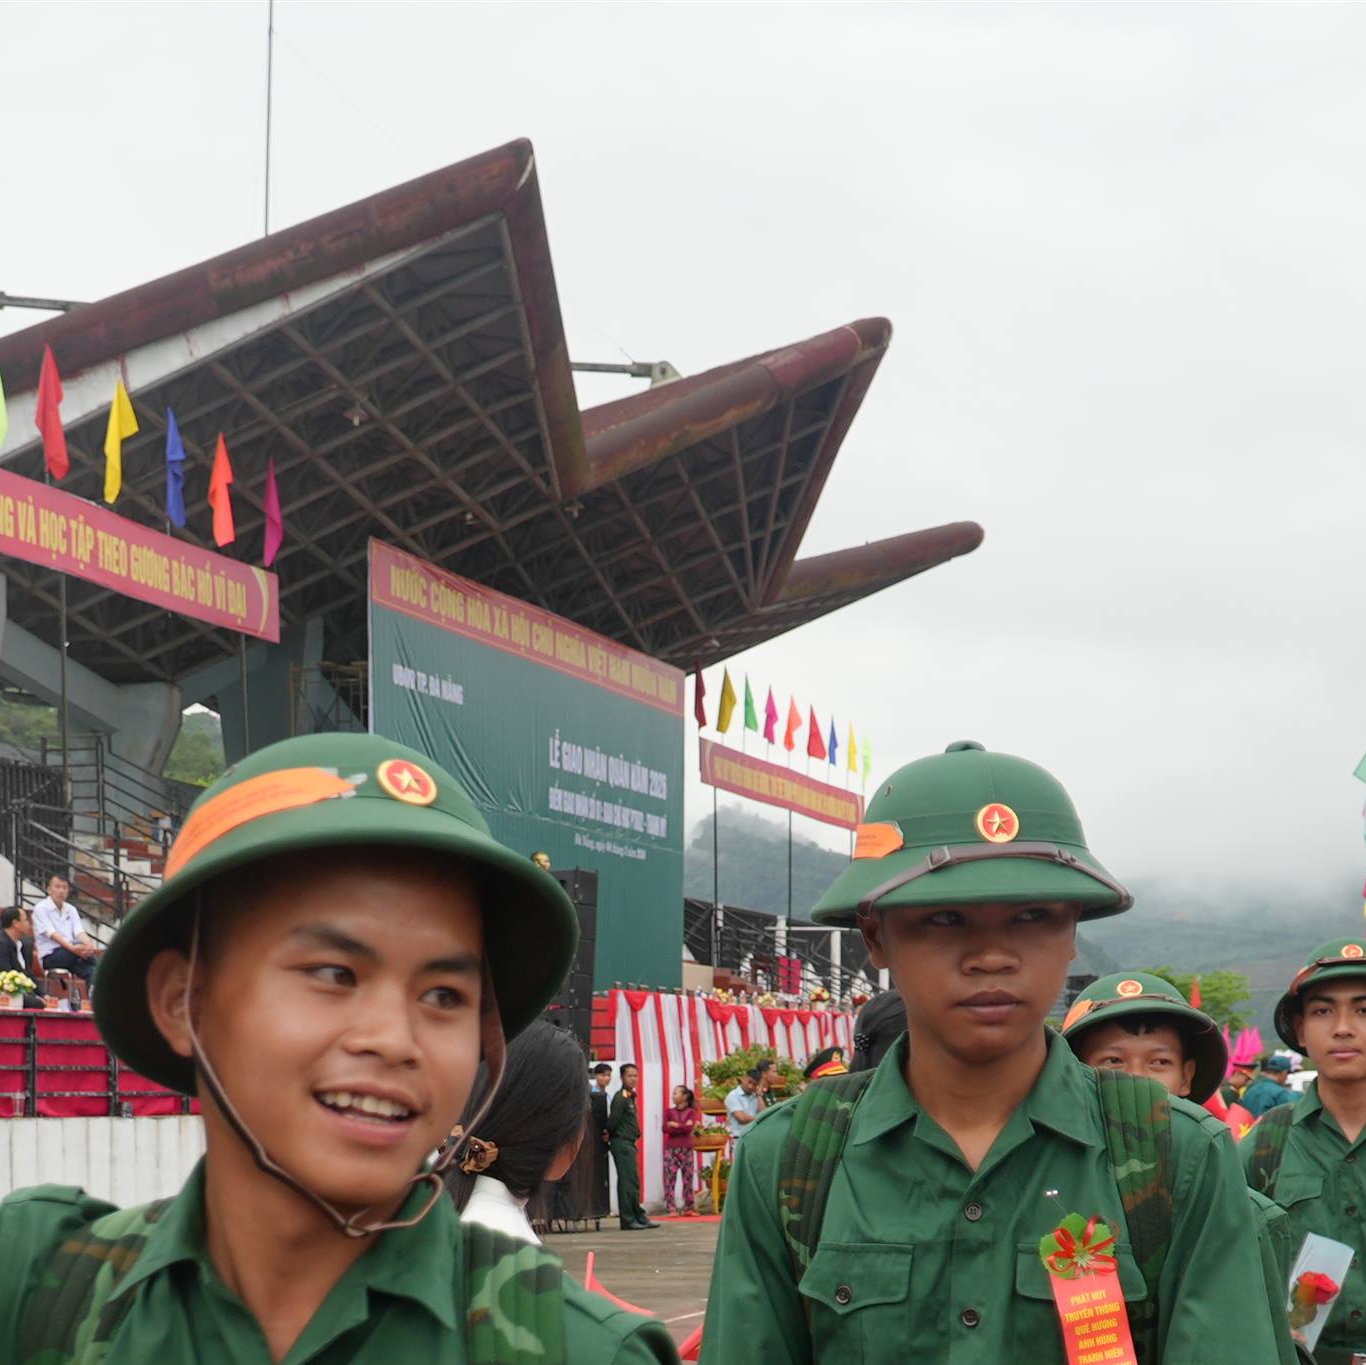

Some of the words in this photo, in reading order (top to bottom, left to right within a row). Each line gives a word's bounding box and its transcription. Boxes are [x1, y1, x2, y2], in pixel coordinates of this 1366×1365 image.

[17, 495, 37, 545] VÀ
[39, 507, 67, 560] HỌC
[69, 514, 94, 570] TẬP
[96, 528, 127, 577] THEO
[172, 555, 196, 601] BÁC
[390, 565, 427, 609] NƯỚC
[430, 580, 464, 623] CỘNG
